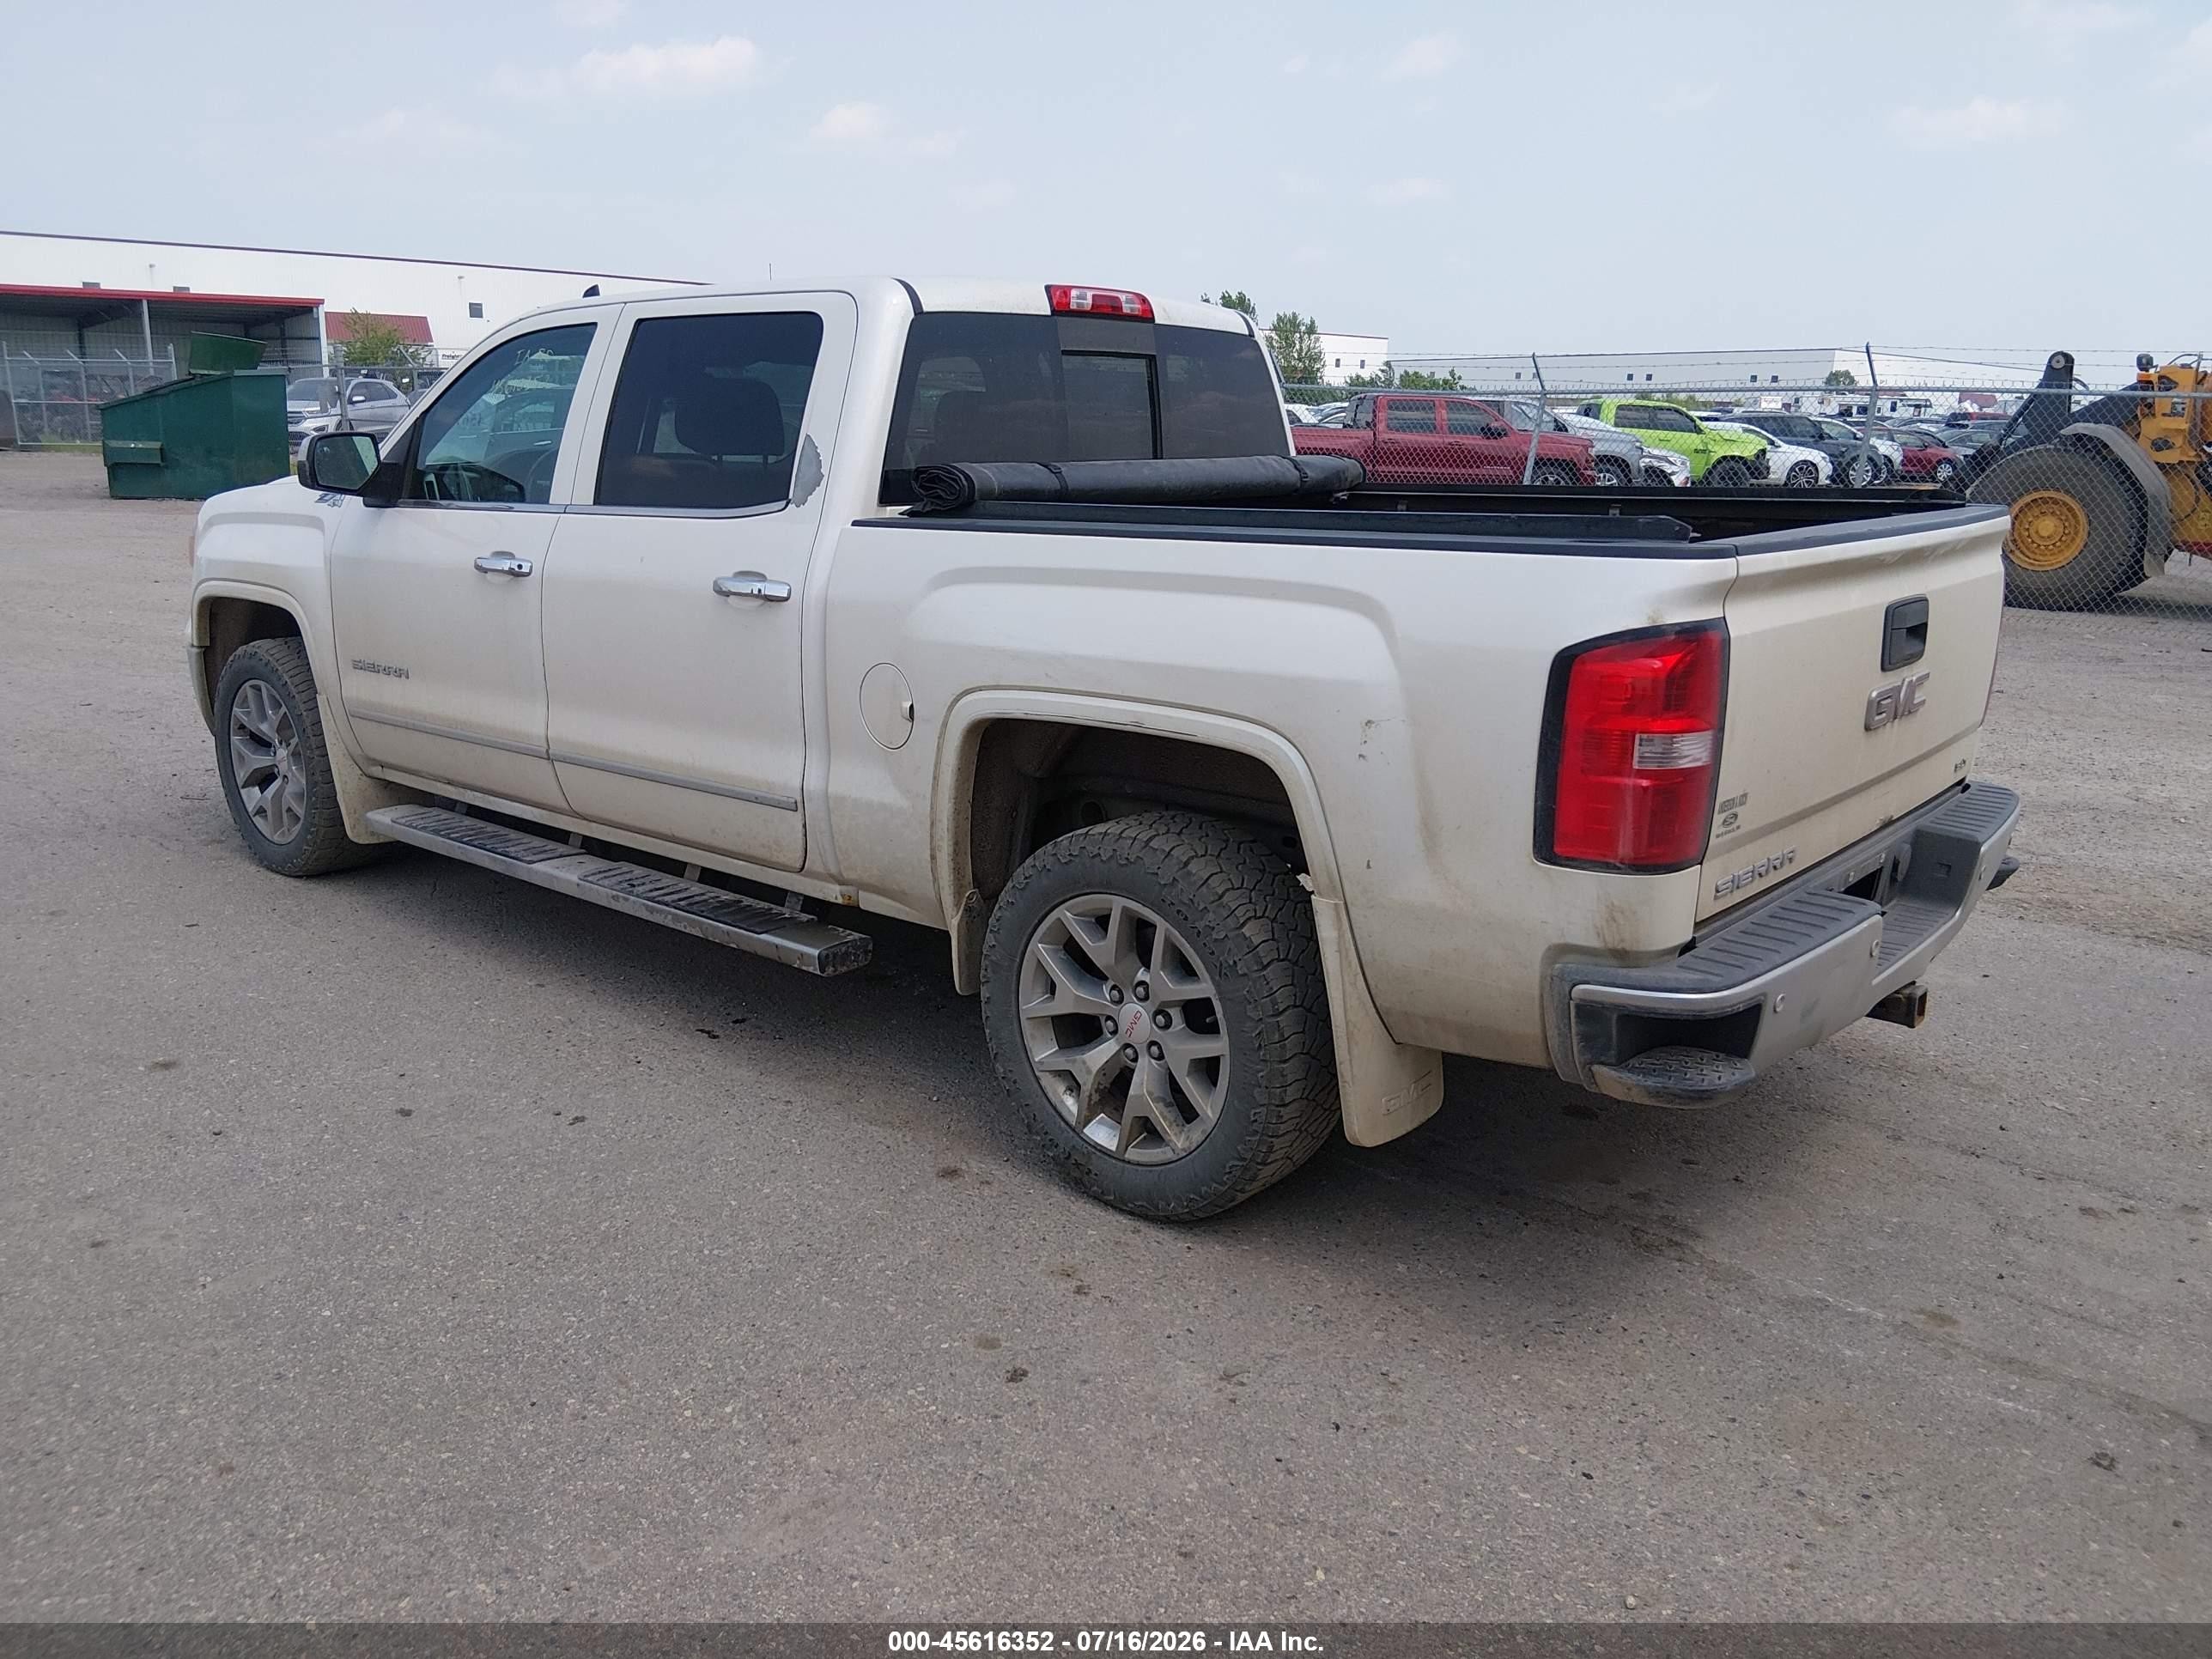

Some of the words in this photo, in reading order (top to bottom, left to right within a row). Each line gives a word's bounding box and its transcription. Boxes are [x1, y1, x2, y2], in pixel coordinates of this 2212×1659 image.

[351, 659, 410, 679] SIERRA
[1864, 672, 1930, 732] GMC
[1712, 846, 1796, 901] SIERRA
[1126, 1010, 1142, 1037] GMC
